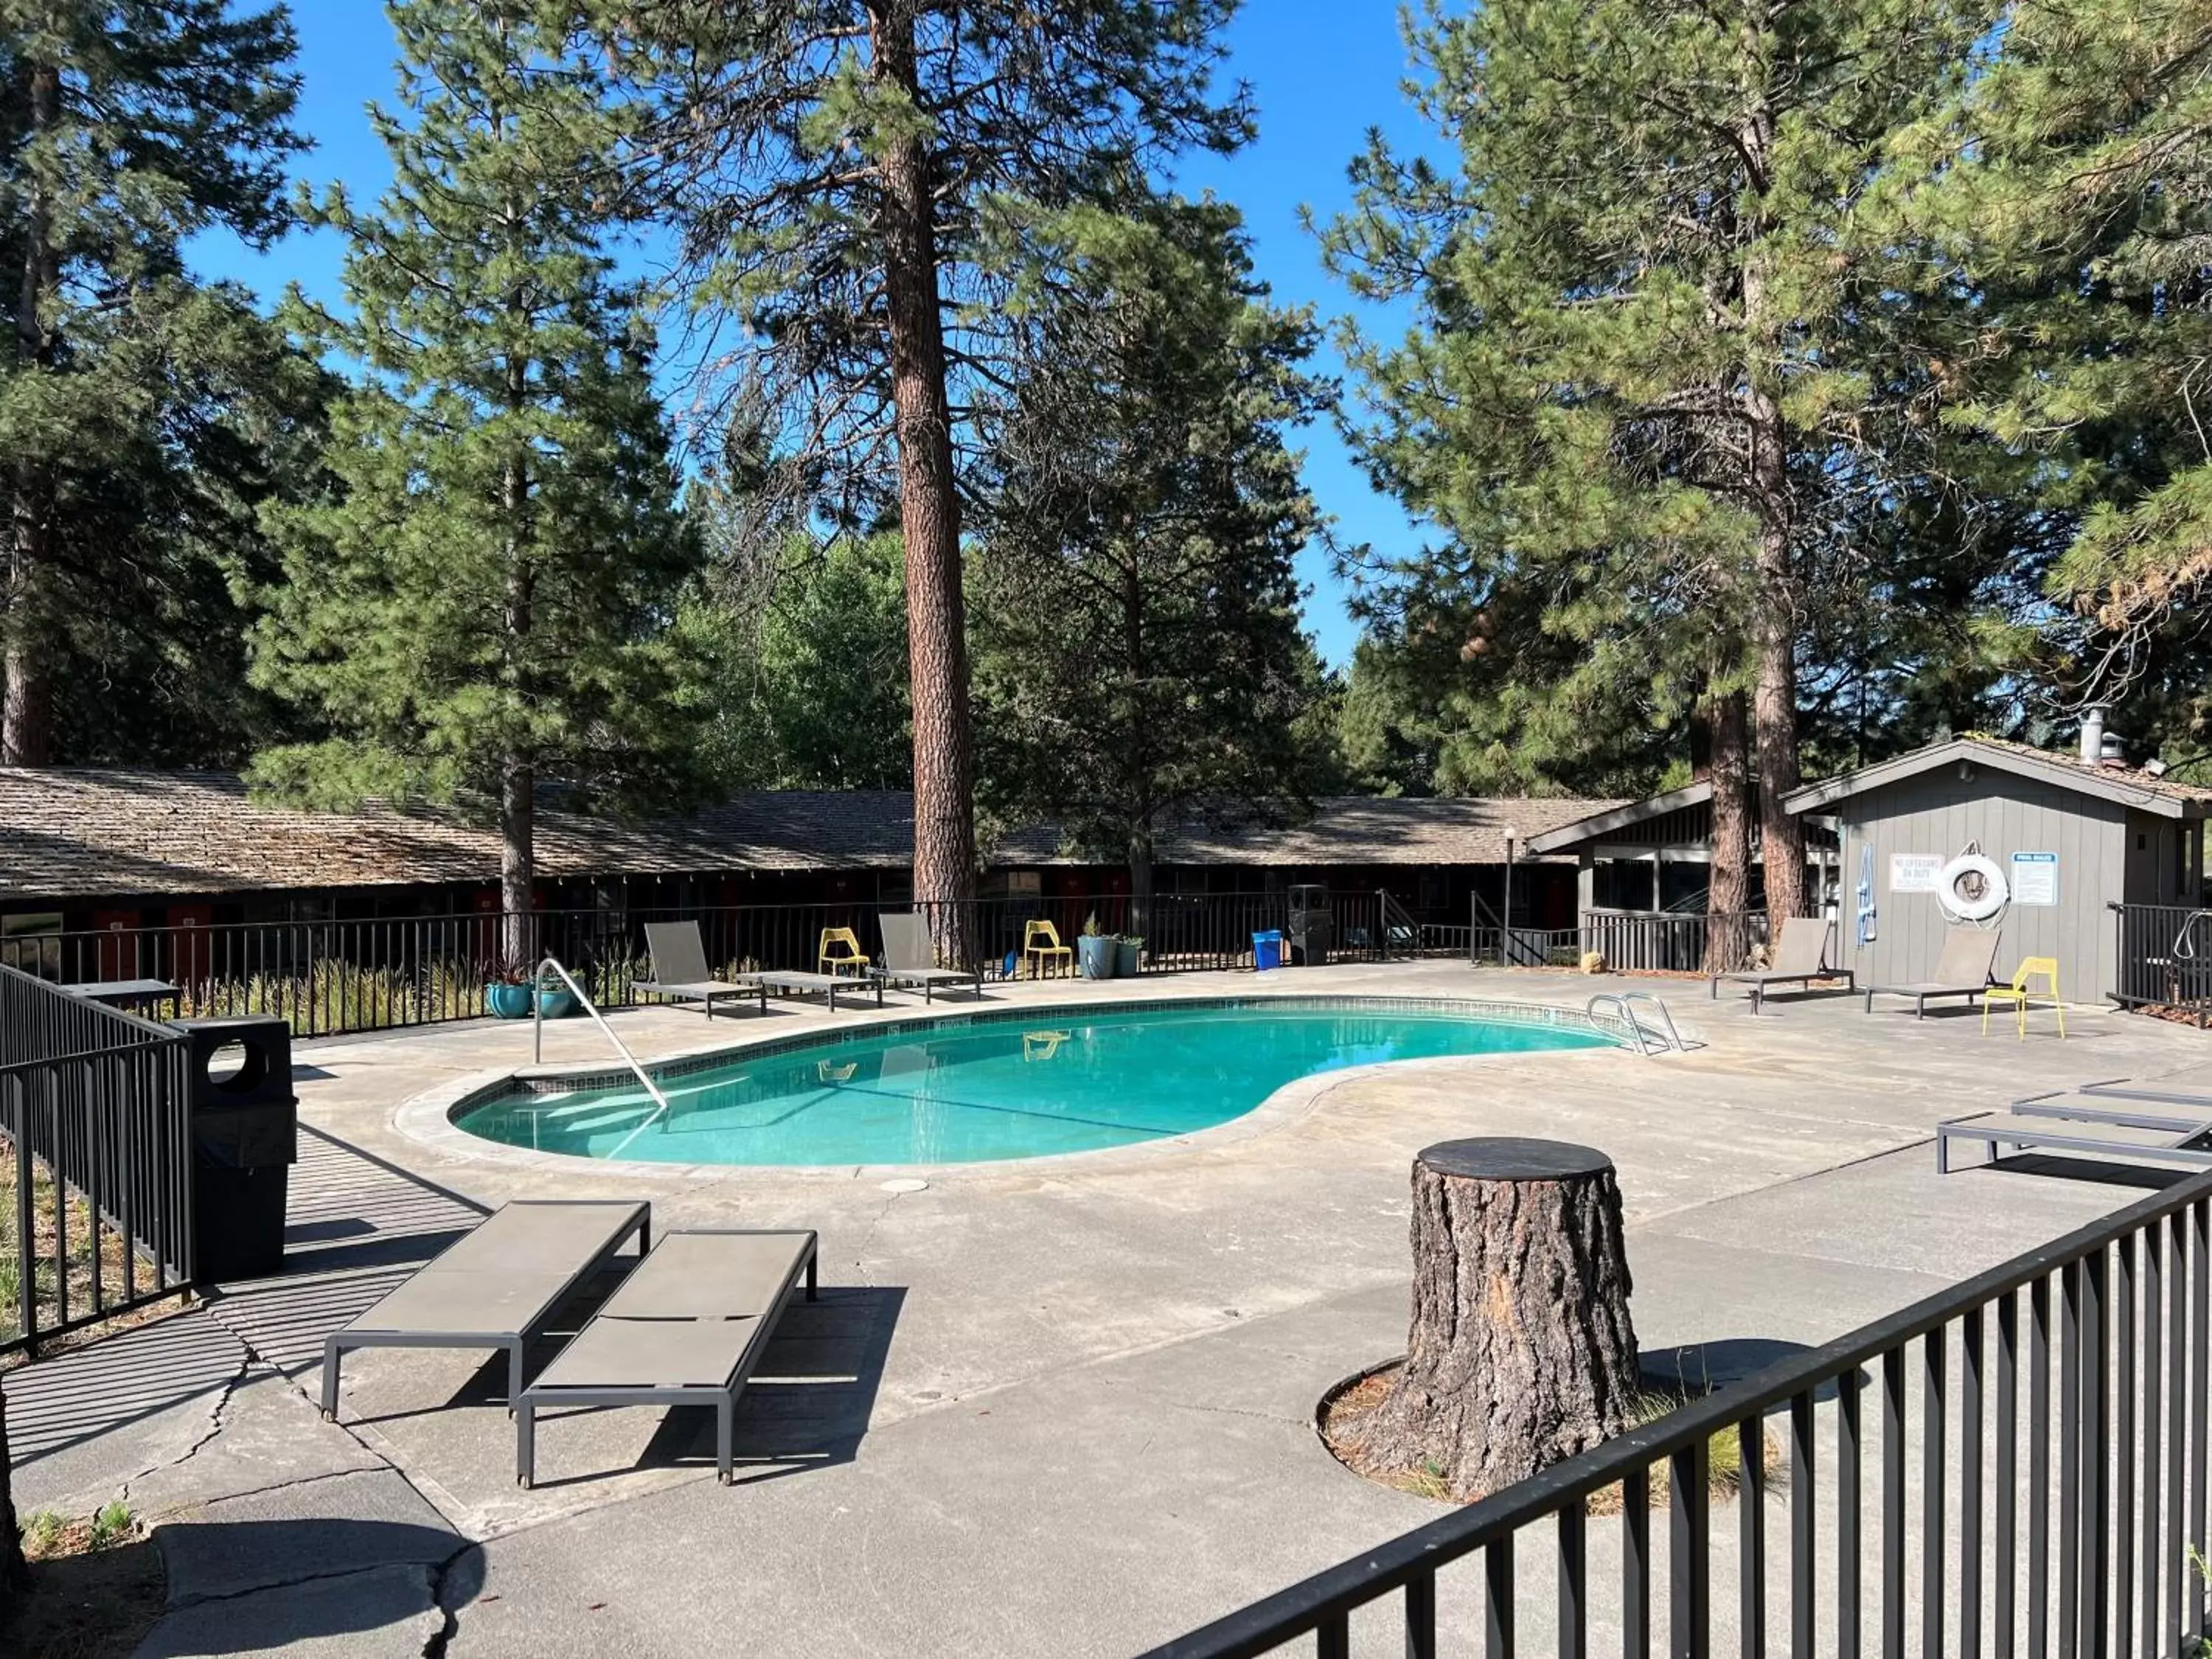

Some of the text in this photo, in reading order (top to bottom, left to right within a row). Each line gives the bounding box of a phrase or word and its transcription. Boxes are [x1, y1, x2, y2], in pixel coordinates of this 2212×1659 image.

[1895, 859, 1904, 868] NO
[1902, 867, 1930, 879] ON DUTY
